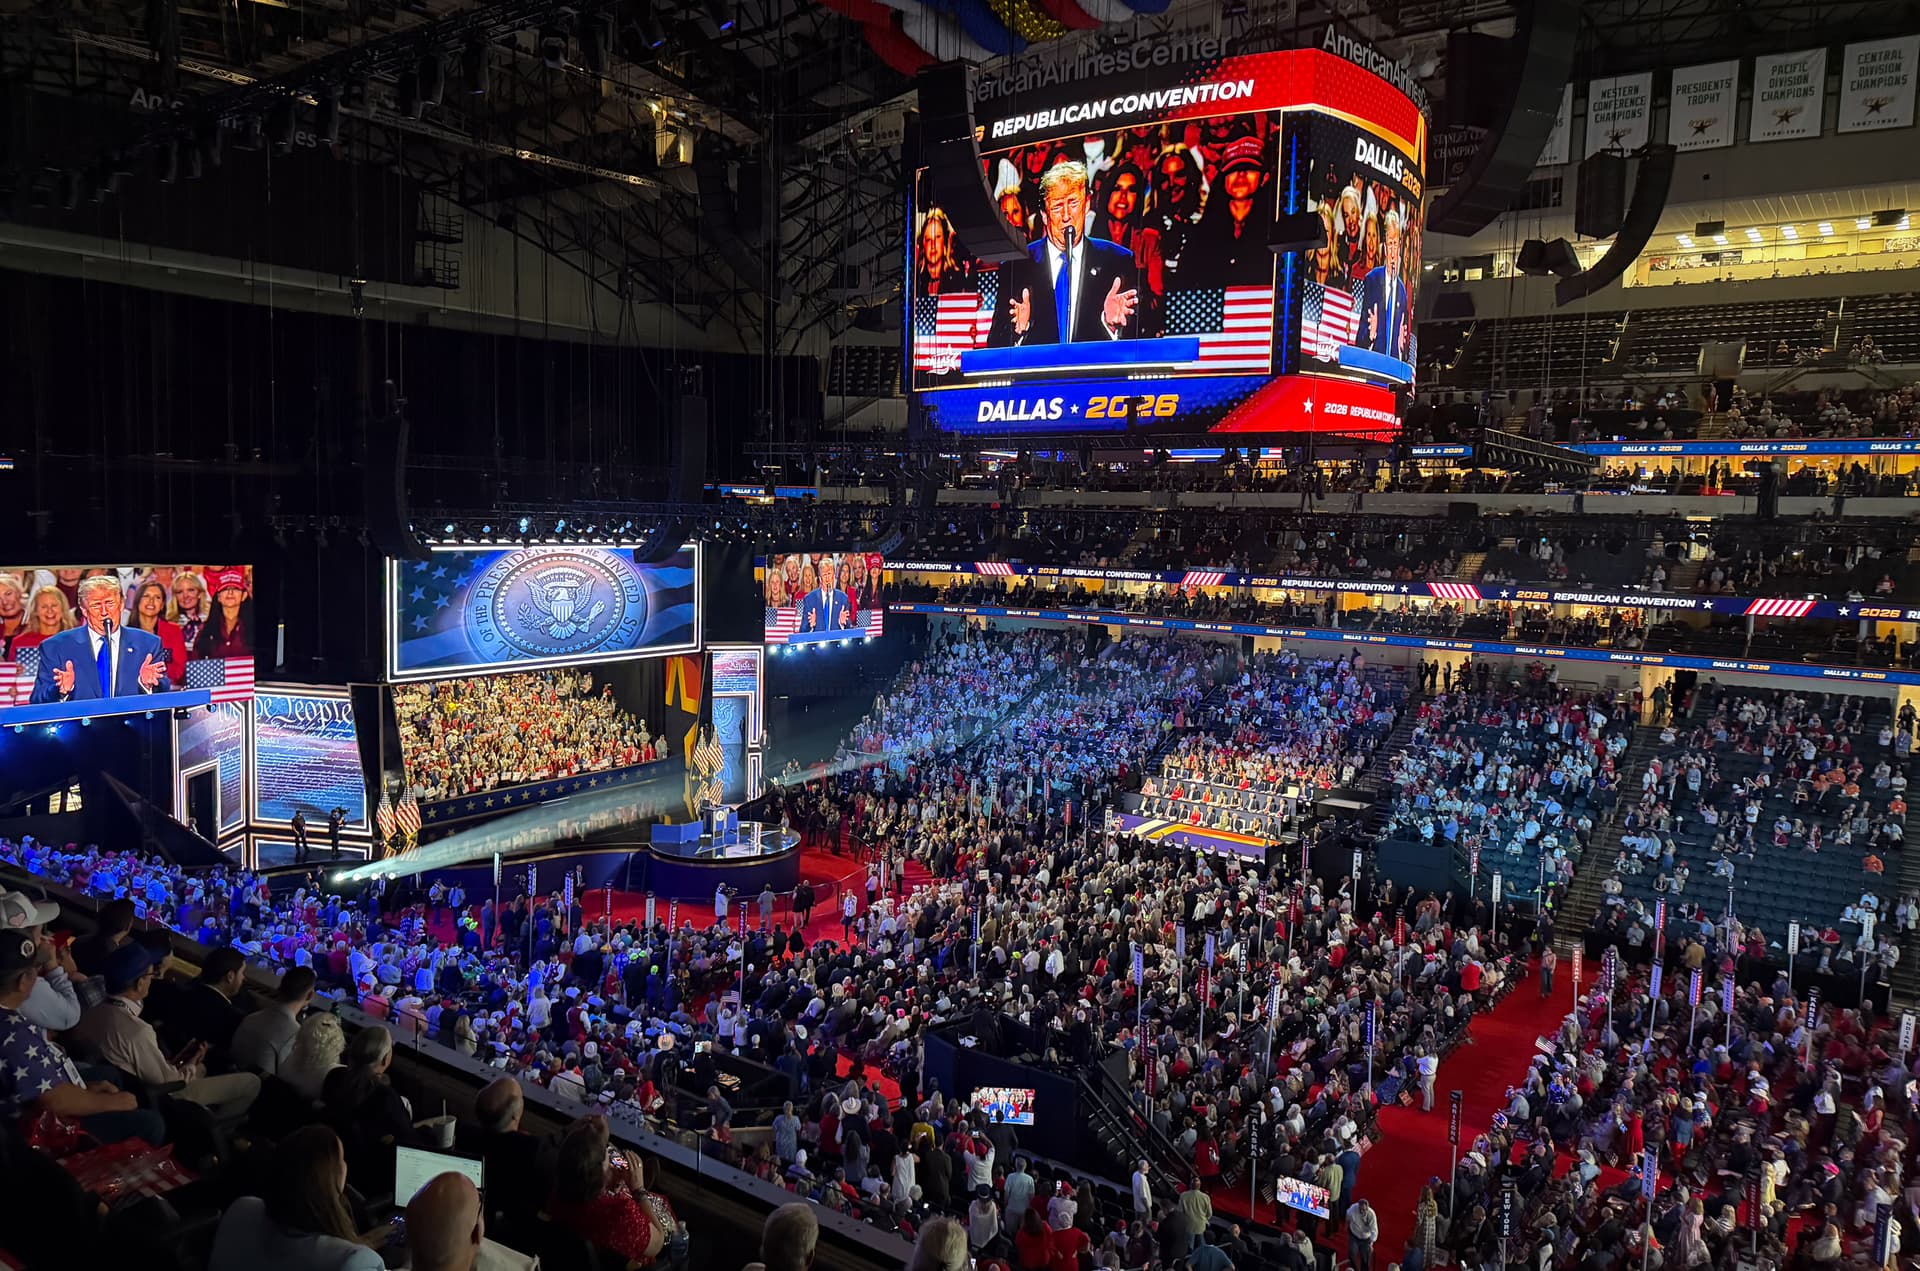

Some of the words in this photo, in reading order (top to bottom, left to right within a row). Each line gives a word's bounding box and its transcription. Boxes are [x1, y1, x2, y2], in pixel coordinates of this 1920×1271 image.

[1858, 50, 1904, 64] CENTRAL
[1771, 62, 1808, 76] PACIFIC
[1859, 63, 1902, 77] DIVISION
[1769, 74, 1809, 88] DIVISION
[1851, 75, 1908, 91] CHAMPIONS
[1601, 85, 1639, 99] WESTERN
[1688, 93, 1720, 106] TROPHY
[1761, 86, 1815, 102] CHAMPIONS
[991, 102, 1105, 138] REPUBLICAN
[1109, 79, 1255, 120] CONVENTION
[1593, 96, 1646, 112] CONFERENCE
[1595, 109, 1642, 123] CHAMPIONS
[1355, 137, 1403, 182] DALLAS
[977, 397, 1064, 423] DALLAS
[1085, 394, 1180, 419] 2026
[1324, 402, 1348, 415] 2026
[1870, 443, 1902, 451] DALLAS
[883, 562, 905, 570] LICAN
[906, 563, 952, 571] CONVENTION
[1037, 567, 1059, 575] 2026
[1062, 568, 1105, 578] REPUBLICAN
[1105, 571, 1152, 580] CONVENTION
[603, 555, 640, 604] UNITED
[1251, 578, 1278, 586] 2026
[1281, 579, 1335, 589] REPUBLICAN
[1337, 581, 1395, 592] CONVENTION
[1516, 590, 1549, 600] 2026
[1553, 593, 1620, 604] REPUBLICAN
[1623, 596, 1696, 608] CONVENTION
[475, 604, 488, 625] THE
[1858, 608, 1902, 618] 2026
[481, 627, 495, 642] OF
[1713, 661, 1738, 669] DALLAS
[1824, 669, 1850, 677] DALLAS
[271, 697, 354, 730] People
[1807, 996, 1817, 1028] KANSAS
[1903, 1017, 1911, 1049] INDIANA
[1450, 1103, 1458, 1143] ARIZONA
[1250, 1118, 1258, 1157] ALASKA
[1645, 1156, 1653, 1199] GEORGIA
[1503, 1192, 1511, 1210] NEW
